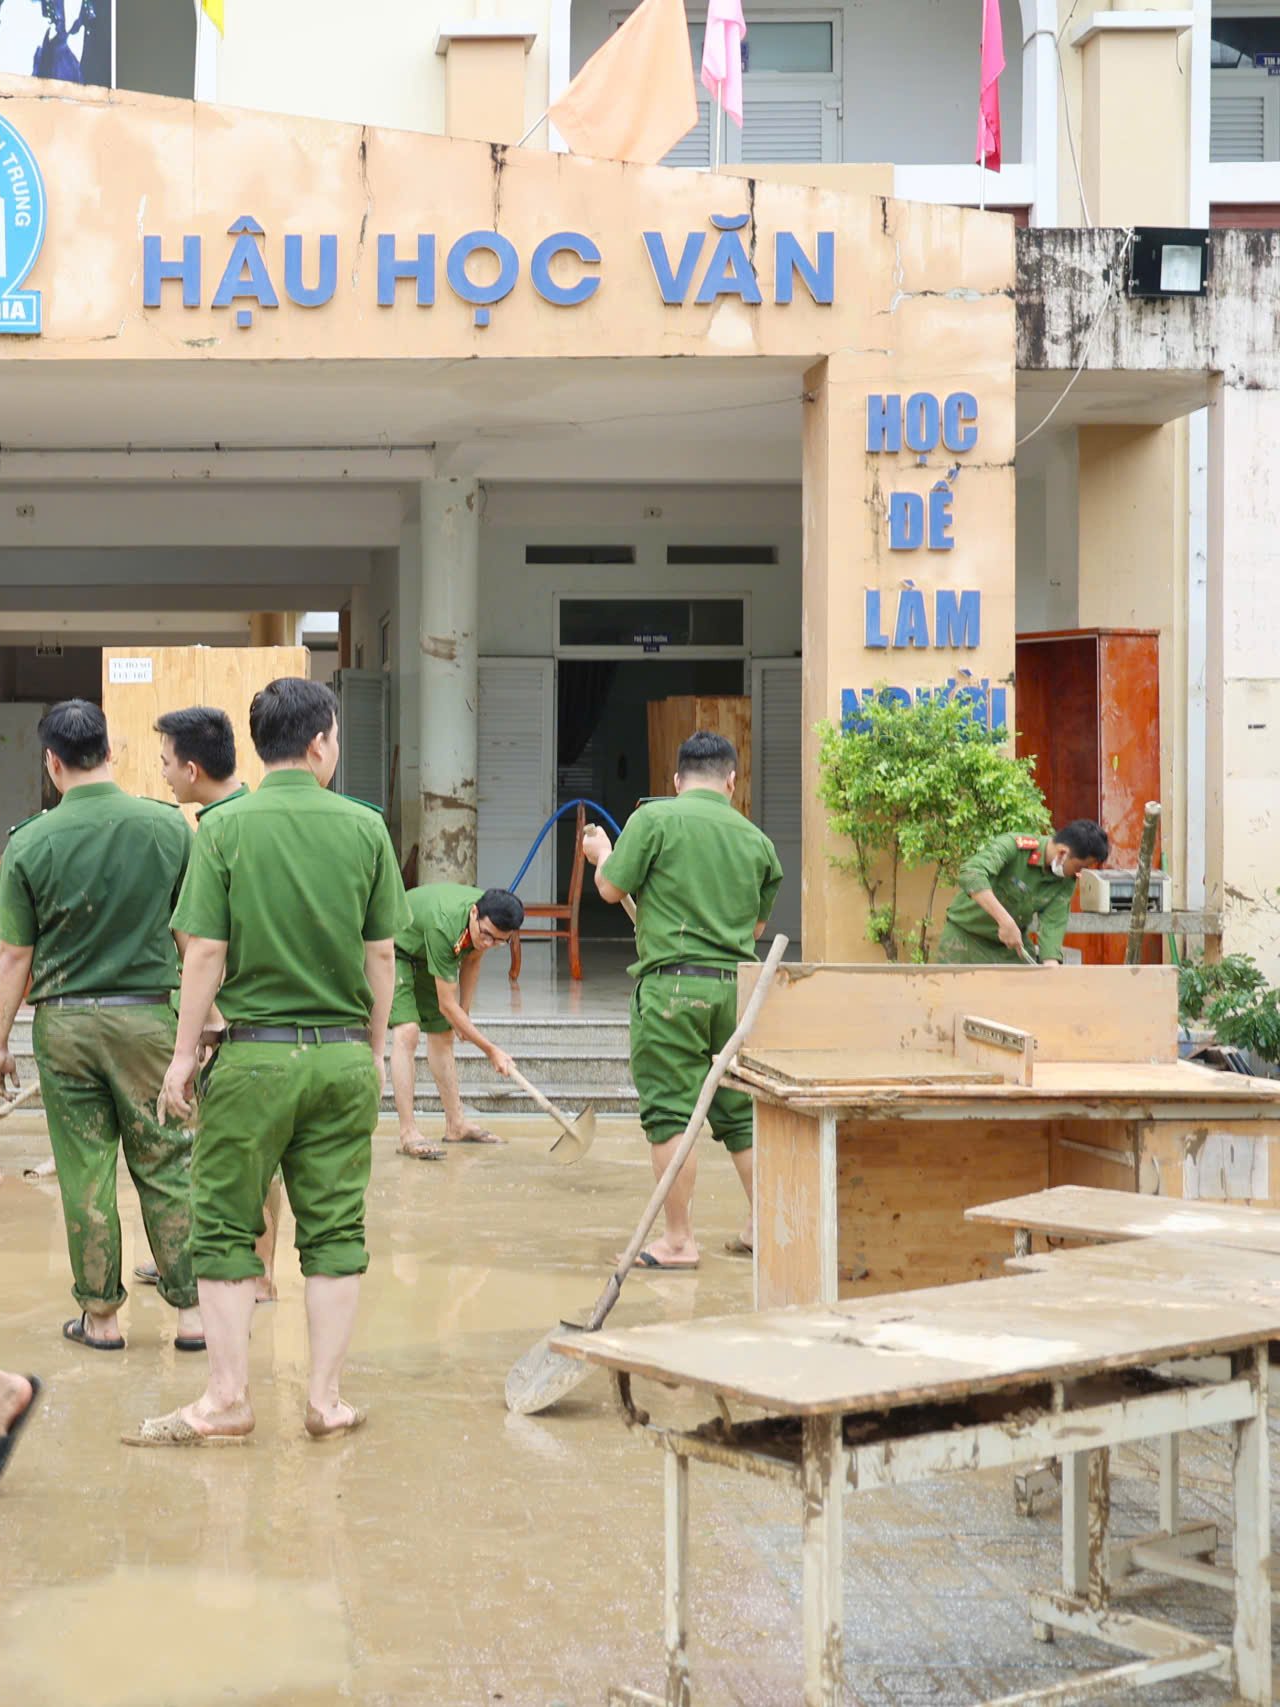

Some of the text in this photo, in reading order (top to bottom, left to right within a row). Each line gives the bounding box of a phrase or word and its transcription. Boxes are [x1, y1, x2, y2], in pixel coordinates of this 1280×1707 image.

[2, 152, 32, 228] TRUNG
[143, 213, 835, 328] HẬU HỌC VĂN
[865, 391, 979, 468] HỌC
[863, 578, 982, 650] LÀM
